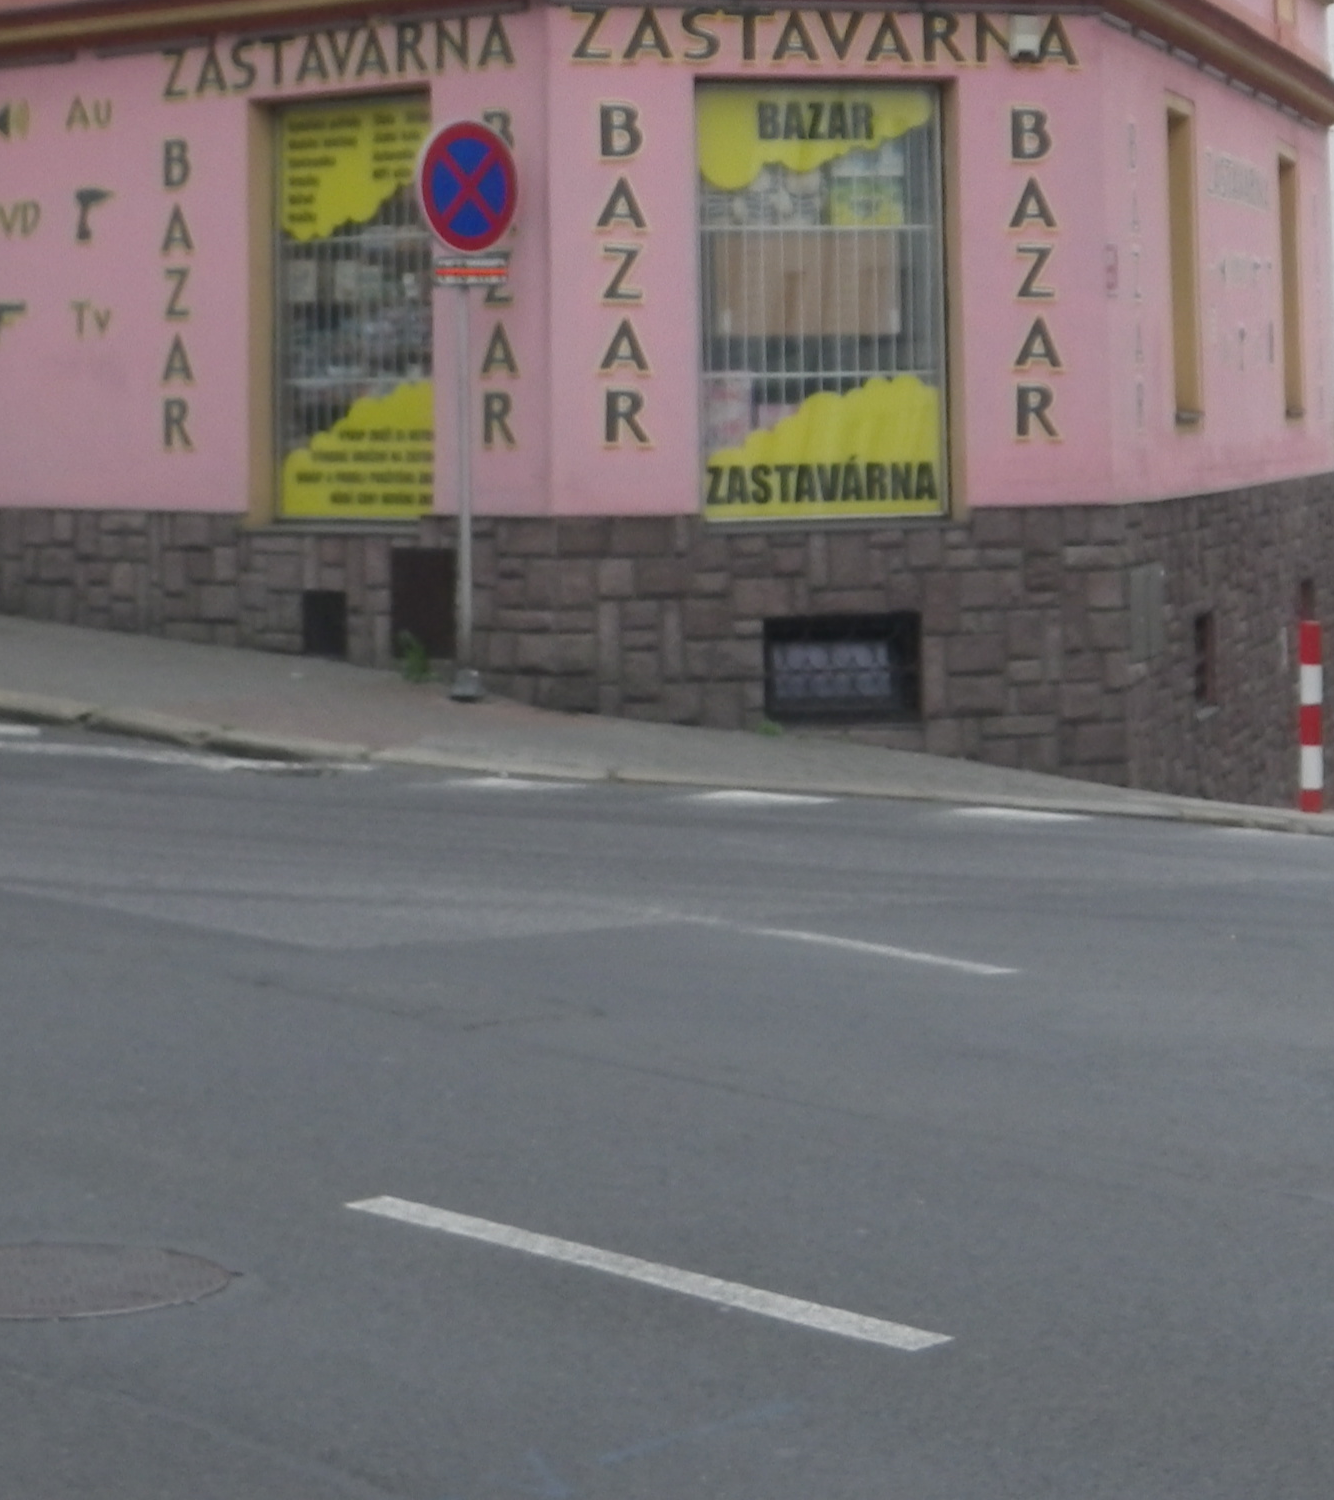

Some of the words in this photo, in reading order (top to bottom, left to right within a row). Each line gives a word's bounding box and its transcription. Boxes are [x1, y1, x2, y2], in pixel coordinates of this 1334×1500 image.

[595, 100, 652, 448] BAZAR
[756, 100, 875, 141] BAZAR
[1007, 105, 1064, 445] BAZAR
[160, 137, 195, 450] BAZAR
[706, 454, 938, 505] ZASTAVÁRNA
